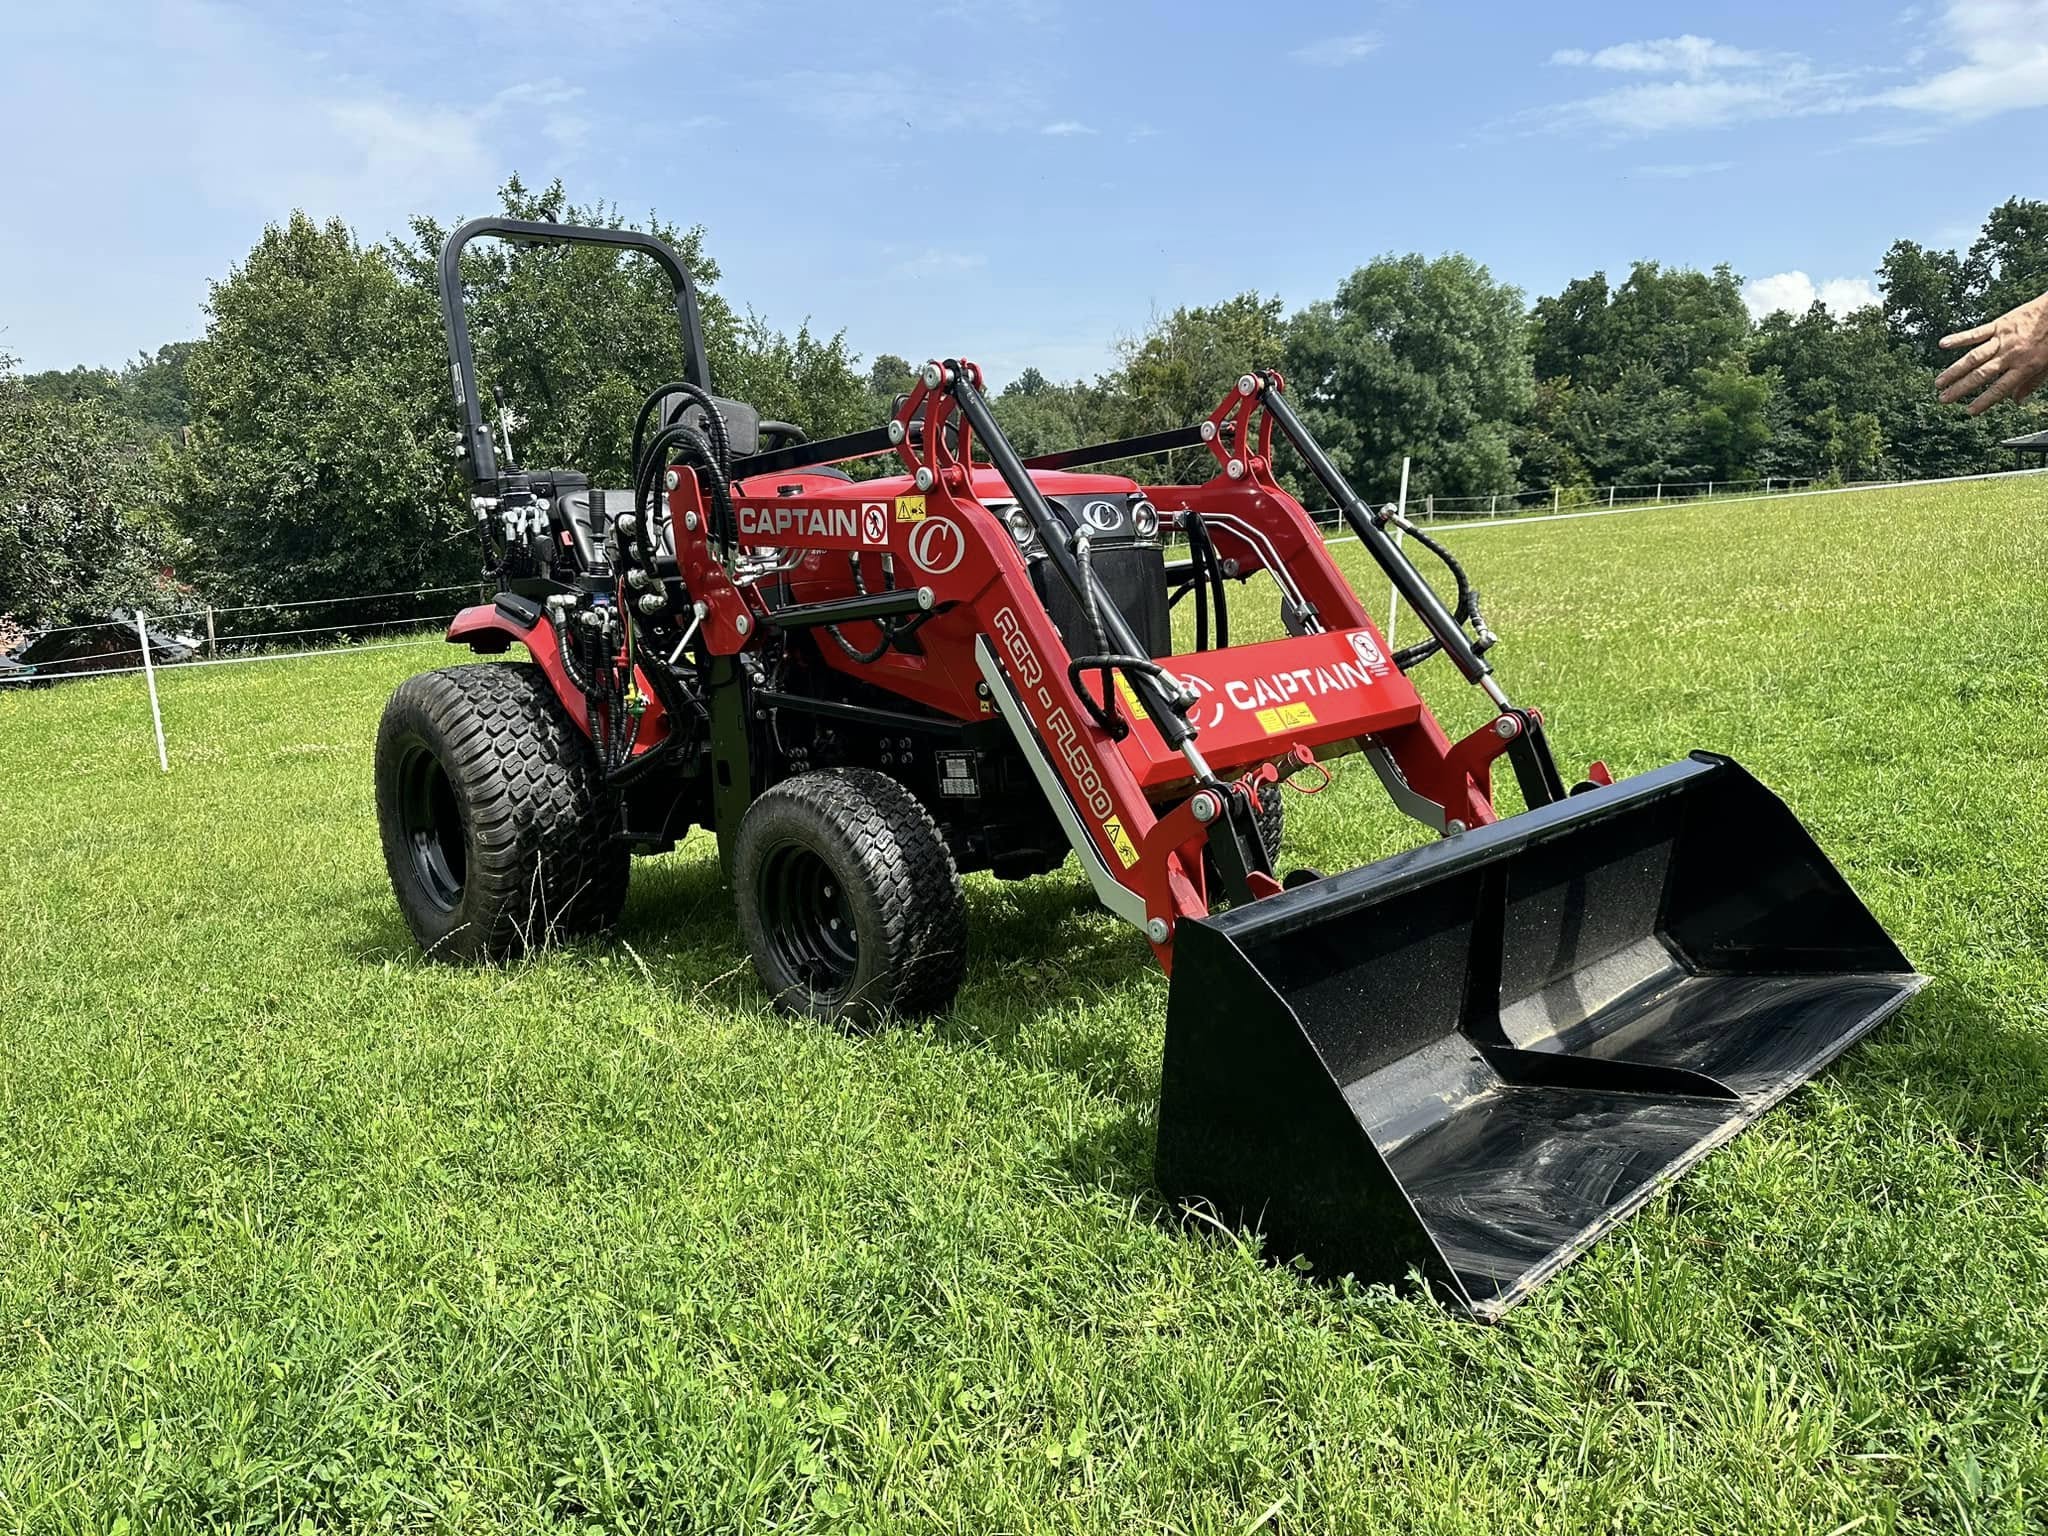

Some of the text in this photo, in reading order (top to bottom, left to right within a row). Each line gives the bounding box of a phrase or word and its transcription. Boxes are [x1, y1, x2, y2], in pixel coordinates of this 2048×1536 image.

[739, 507, 857, 537] CAPTAIN
[1224, 660, 1373, 710] CAPTAIN
[993, 606, 1043, 688] AGR
[1046, 707, 1113, 819] FL500
